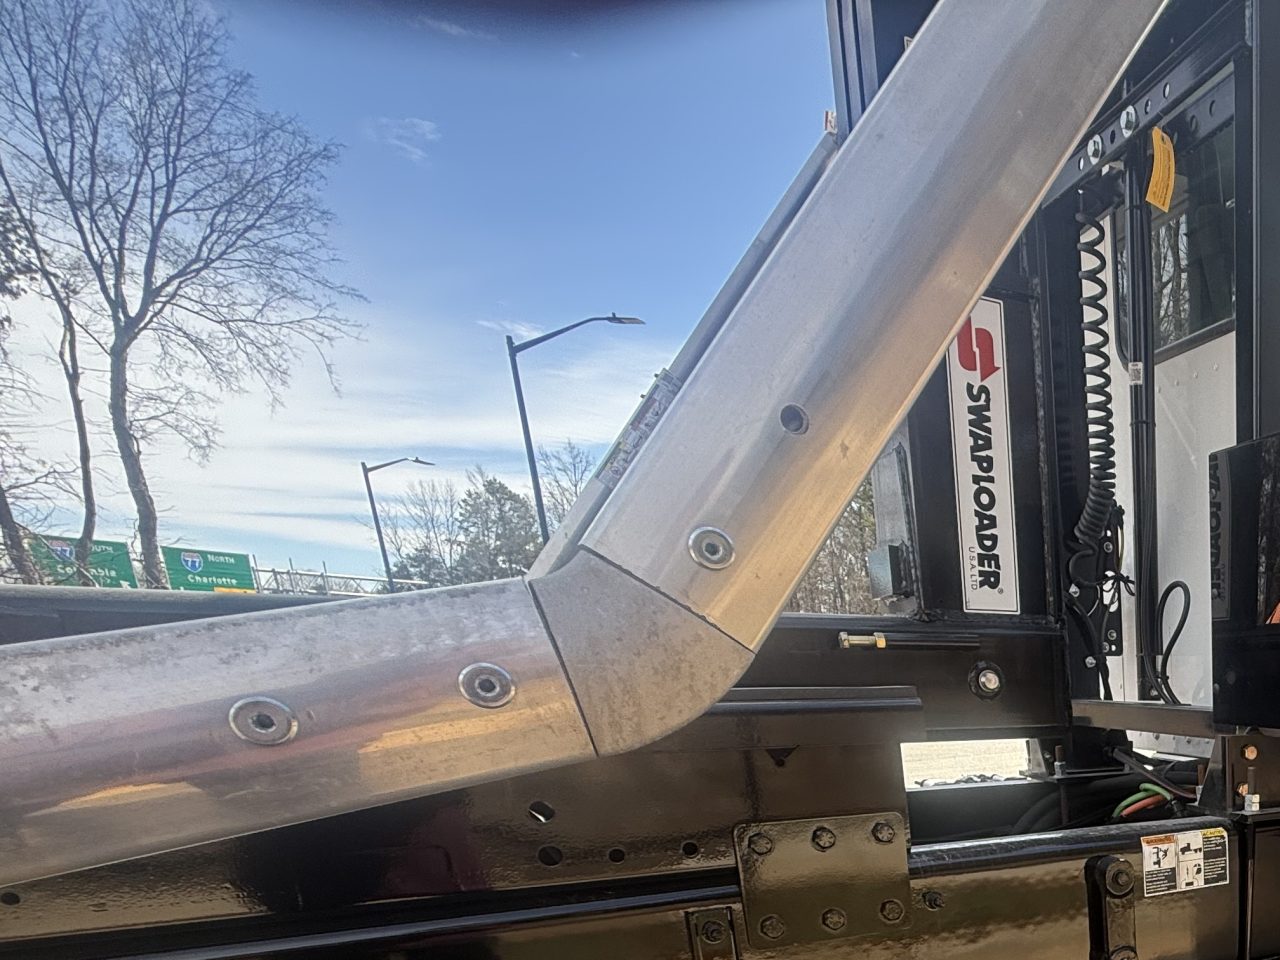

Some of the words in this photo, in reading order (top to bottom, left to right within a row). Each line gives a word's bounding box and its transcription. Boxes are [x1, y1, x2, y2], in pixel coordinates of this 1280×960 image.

[966, 381, 1001, 590] SWAPLOADER
[183, 557, 200, 568] 77
[207, 554, 235, 564] NORTH
[187, 574, 238, 586] Charlotte
